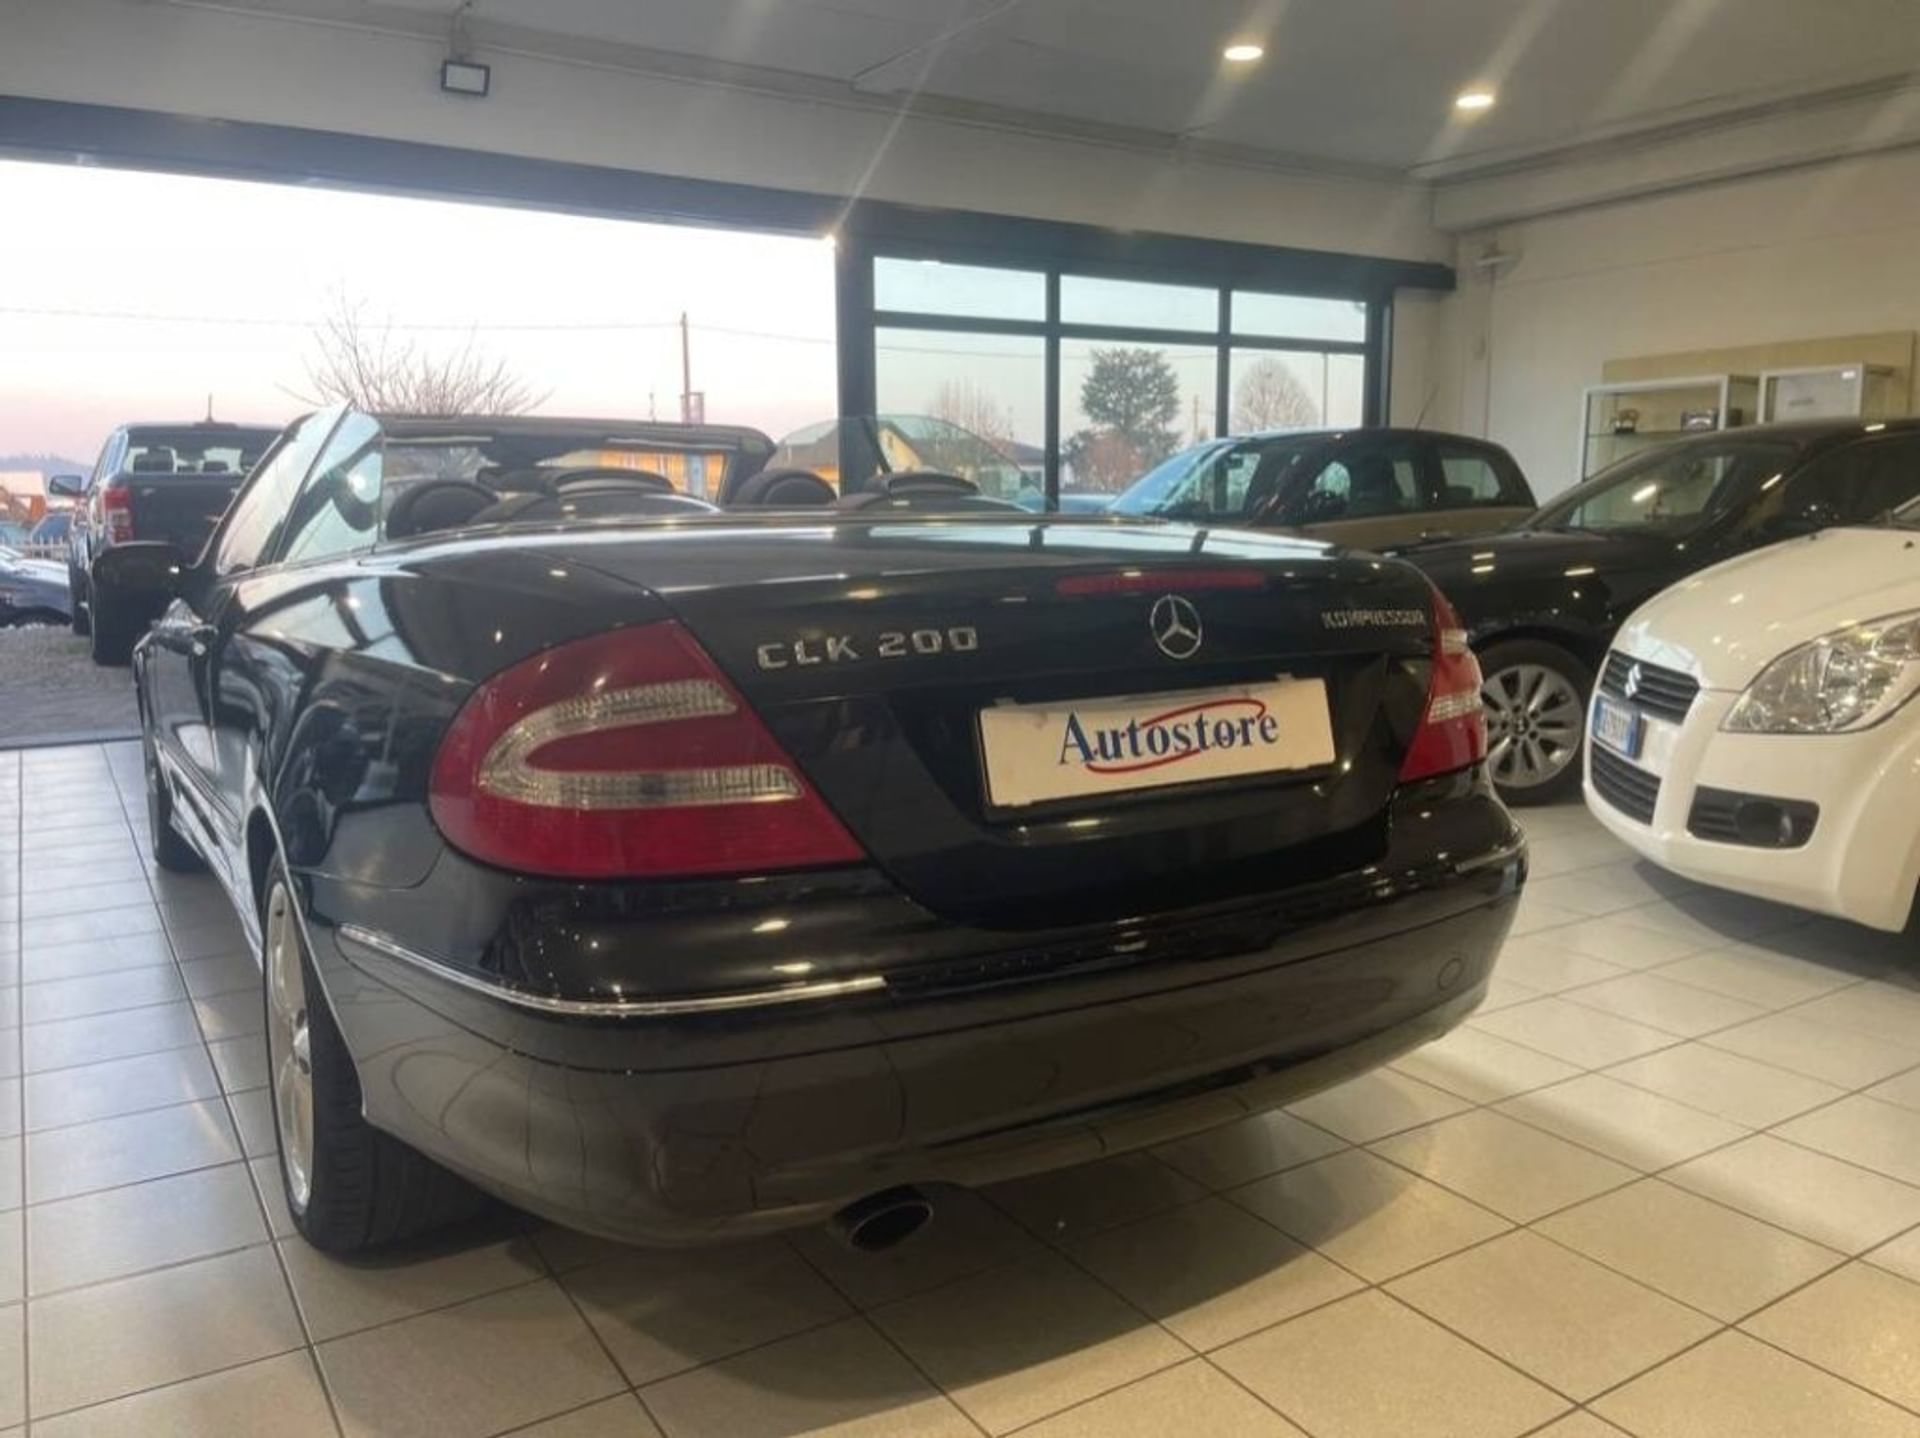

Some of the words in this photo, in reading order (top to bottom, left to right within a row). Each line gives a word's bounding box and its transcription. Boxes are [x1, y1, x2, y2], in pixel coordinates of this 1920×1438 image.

[757, 635, 860, 670] CLK
[878, 626, 979, 658] 200
[1058, 710, 1279, 766] Autostore
